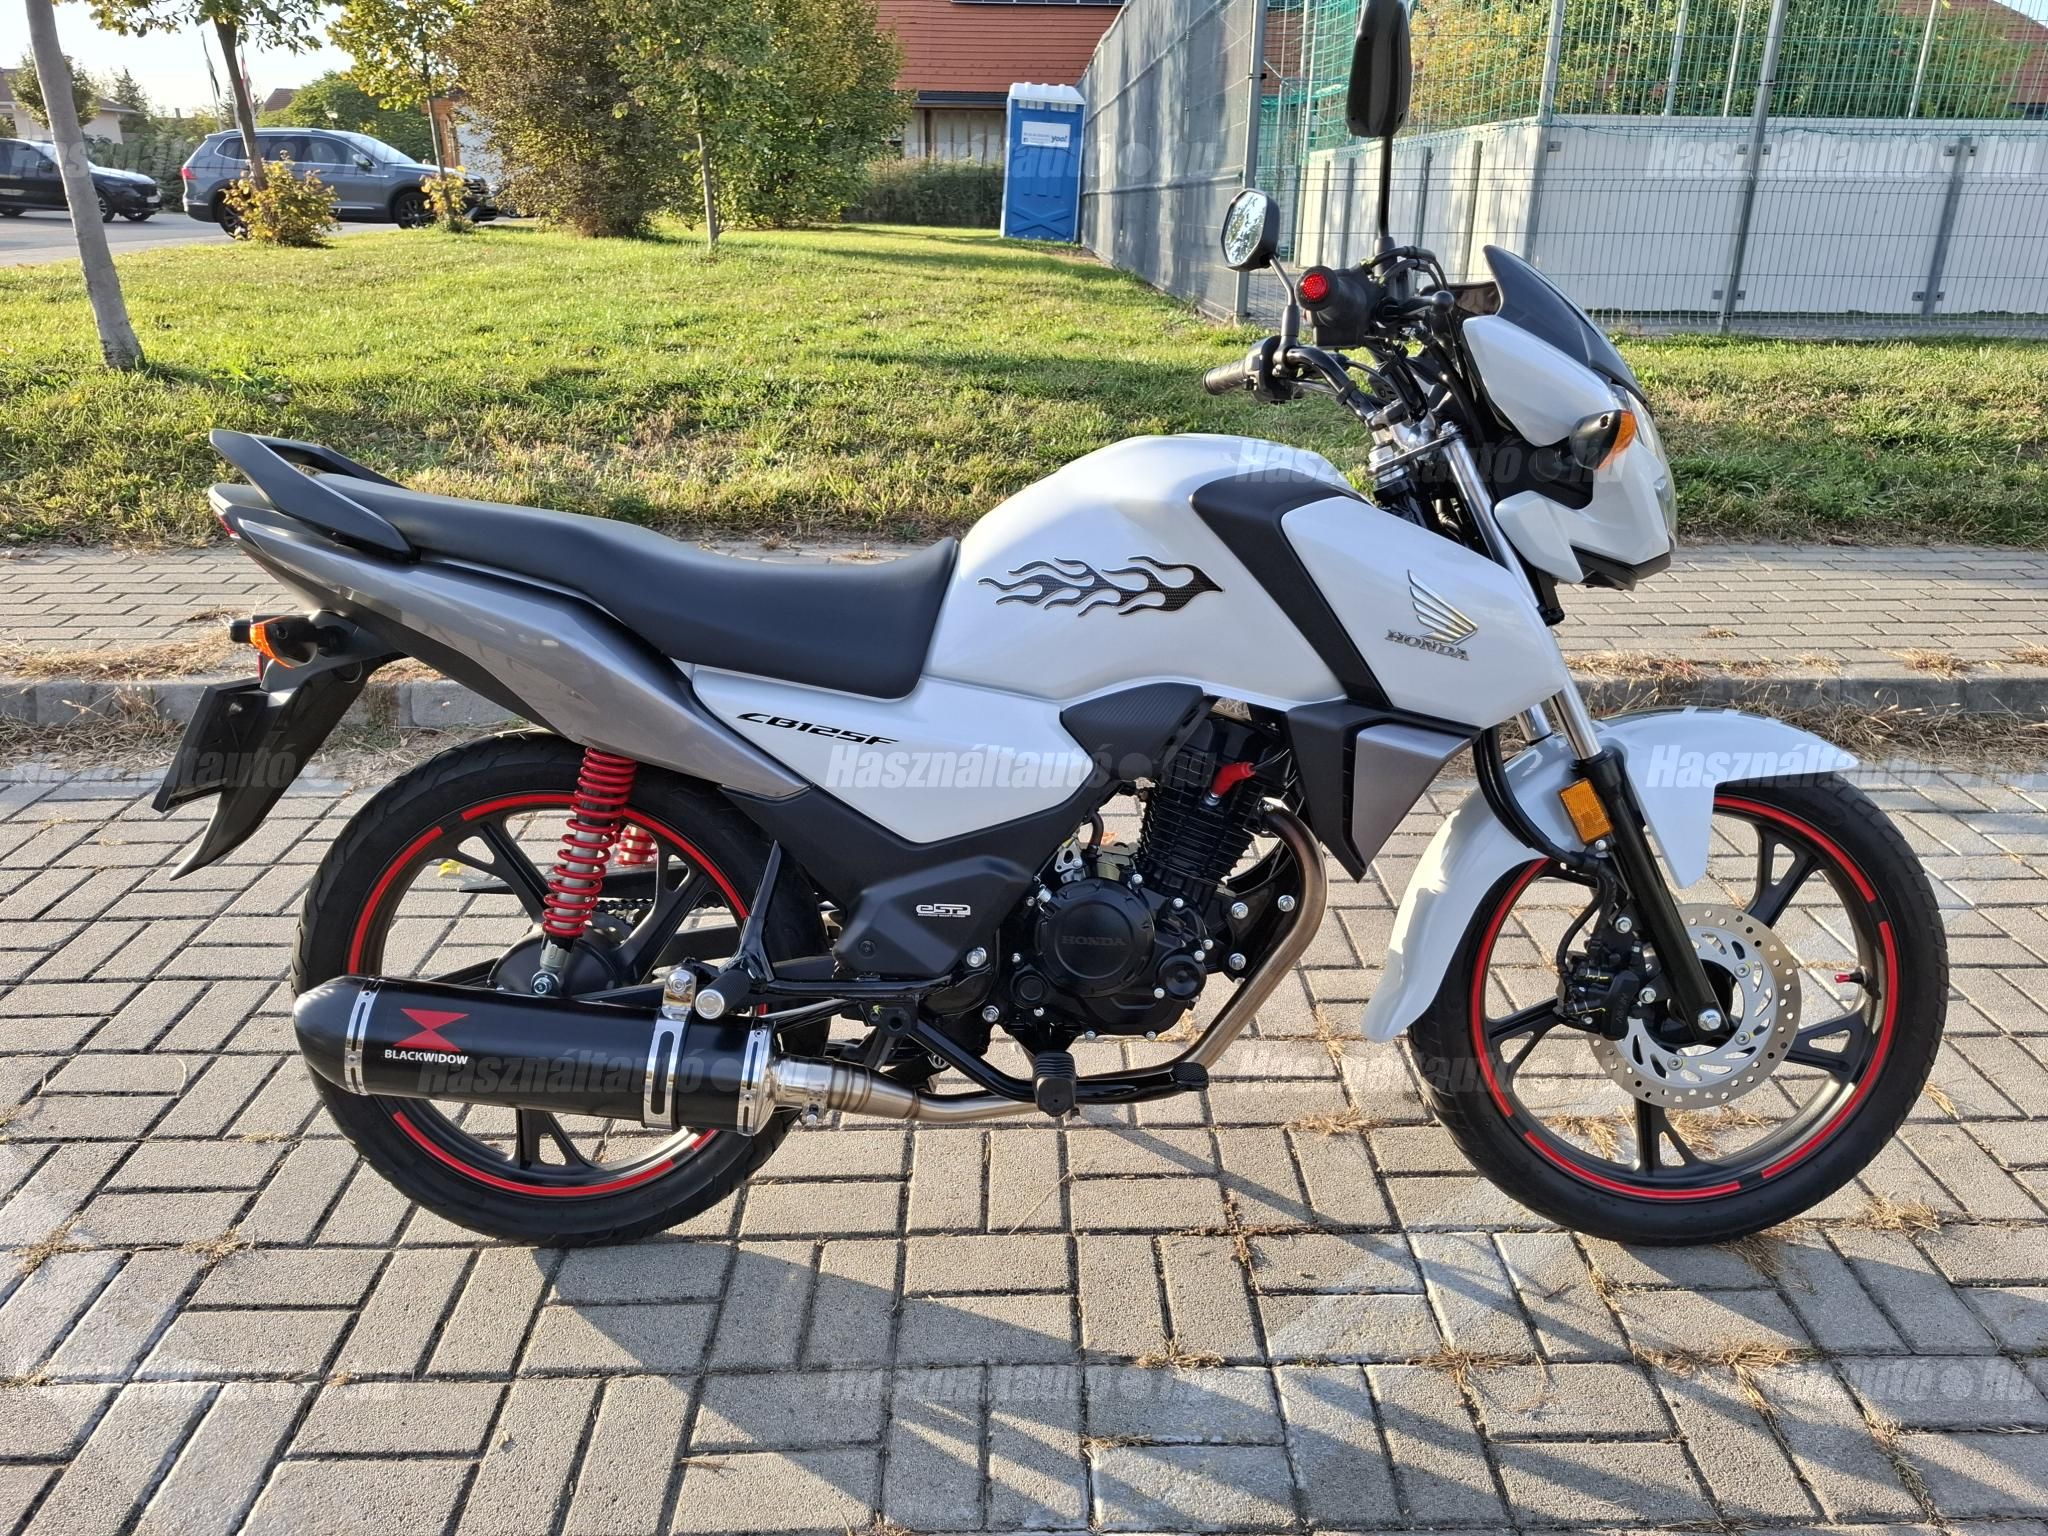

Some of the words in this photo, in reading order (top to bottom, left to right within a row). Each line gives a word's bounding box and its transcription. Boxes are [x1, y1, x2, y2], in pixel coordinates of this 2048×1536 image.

[1384, 629, 1469, 661] HONDA
[736, 712, 899, 745] CB125F
[1061, 935, 1127, 946] HONDA
[384, 1049, 469, 1065] BLACKWIDOW
